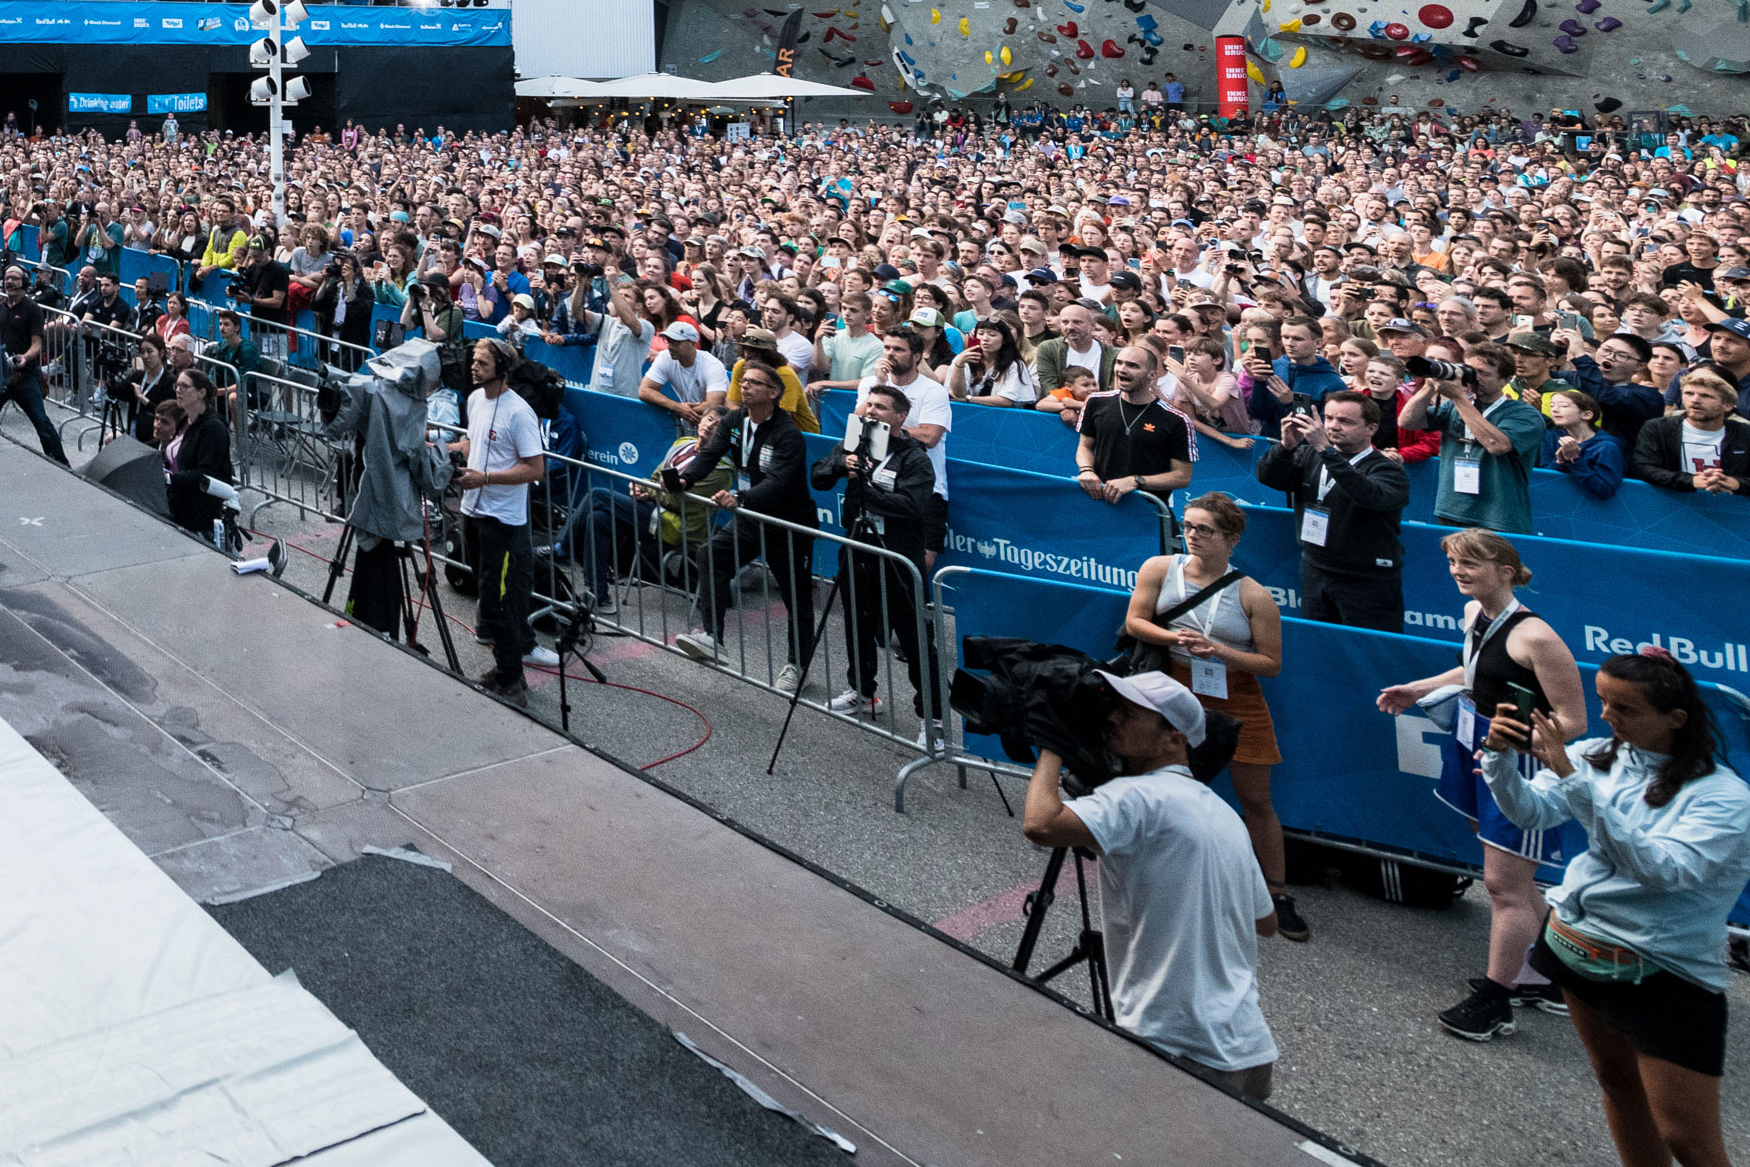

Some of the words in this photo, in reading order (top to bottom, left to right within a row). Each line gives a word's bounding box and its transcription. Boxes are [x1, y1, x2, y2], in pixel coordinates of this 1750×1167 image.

[79, 96, 109, 111] Drinking
[110, 99, 129, 109] water
[173, 95, 204, 111] Toilets
[587, 449, 619, 466] erein
[993, 537, 1139, 592] Tageszeitung
